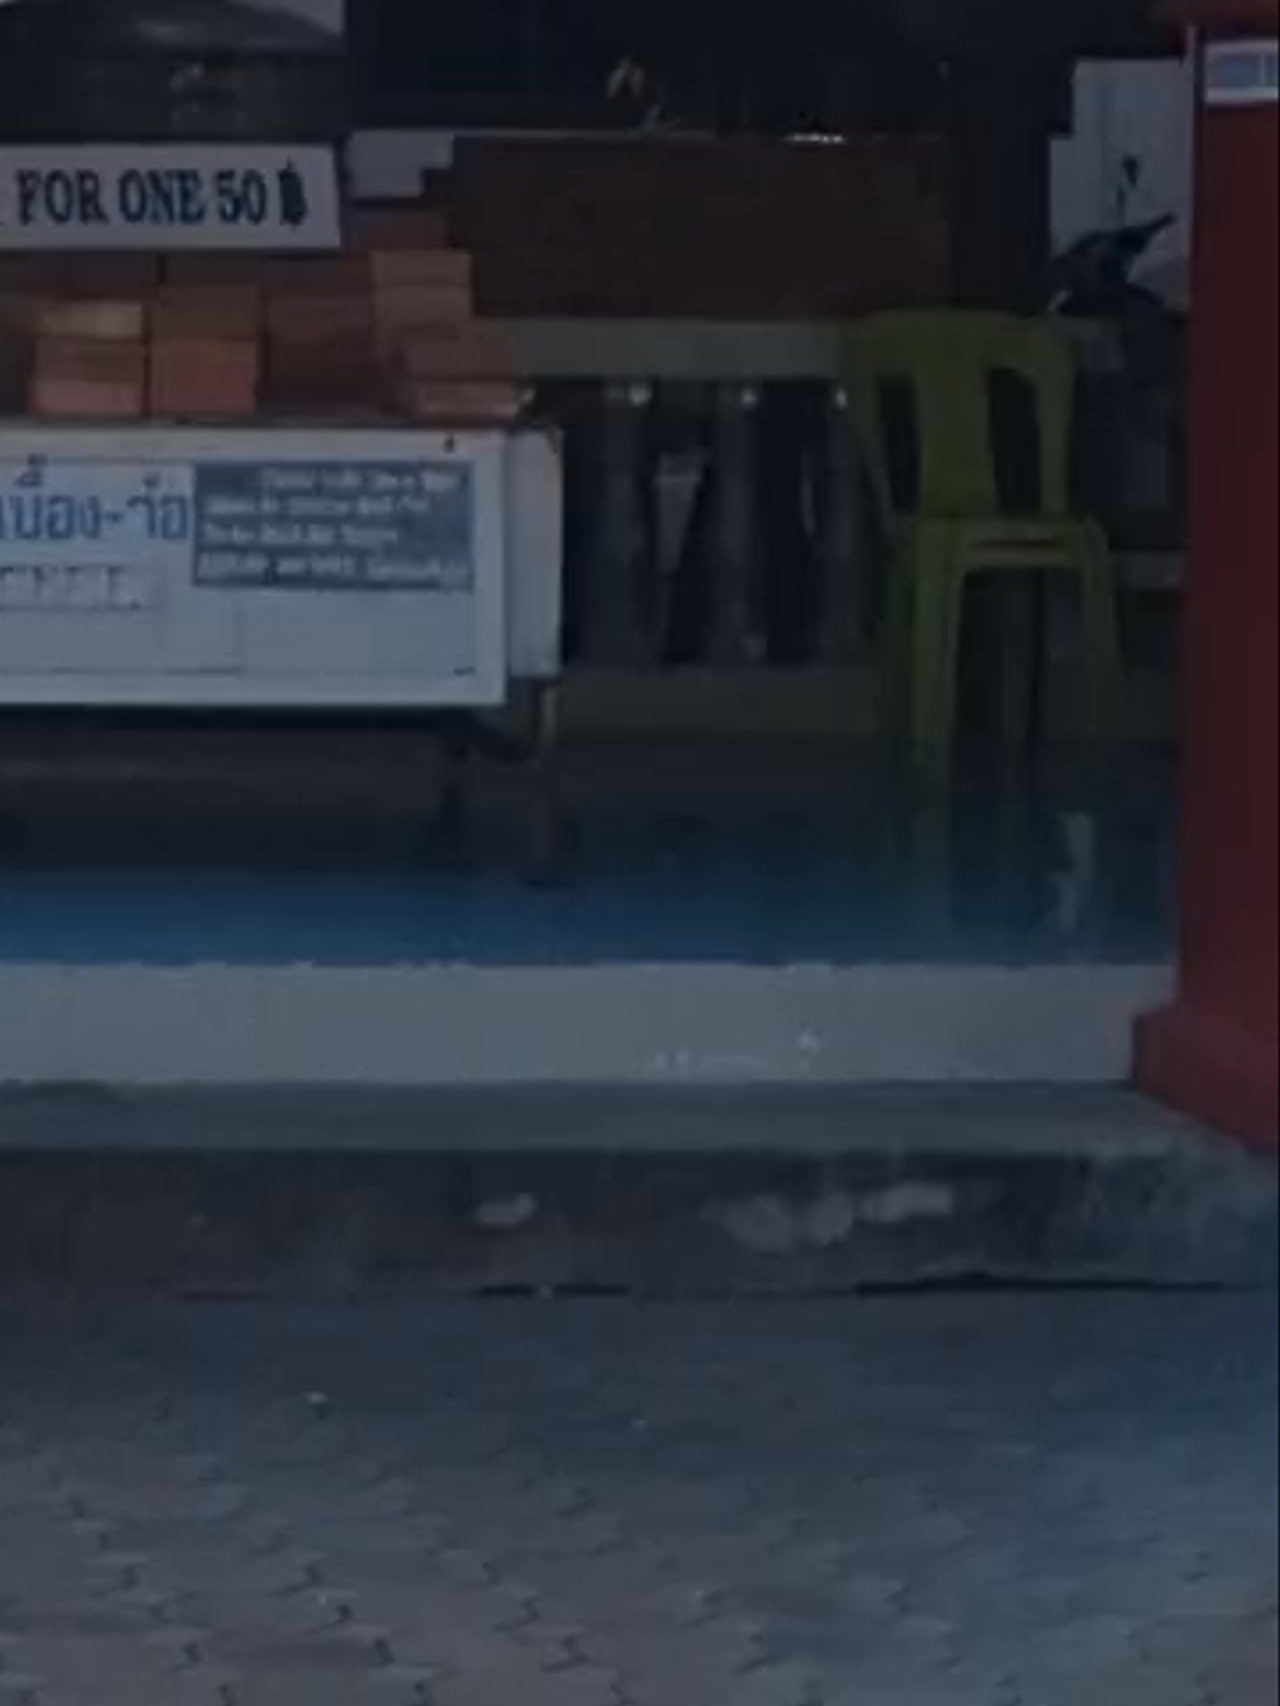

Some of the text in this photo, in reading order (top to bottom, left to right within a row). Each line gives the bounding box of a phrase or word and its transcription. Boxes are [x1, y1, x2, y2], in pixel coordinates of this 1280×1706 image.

[16, 168, 109, 226] FOR
[118, 168, 205, 226] ONE
[215, 168, 267, 226] 50
